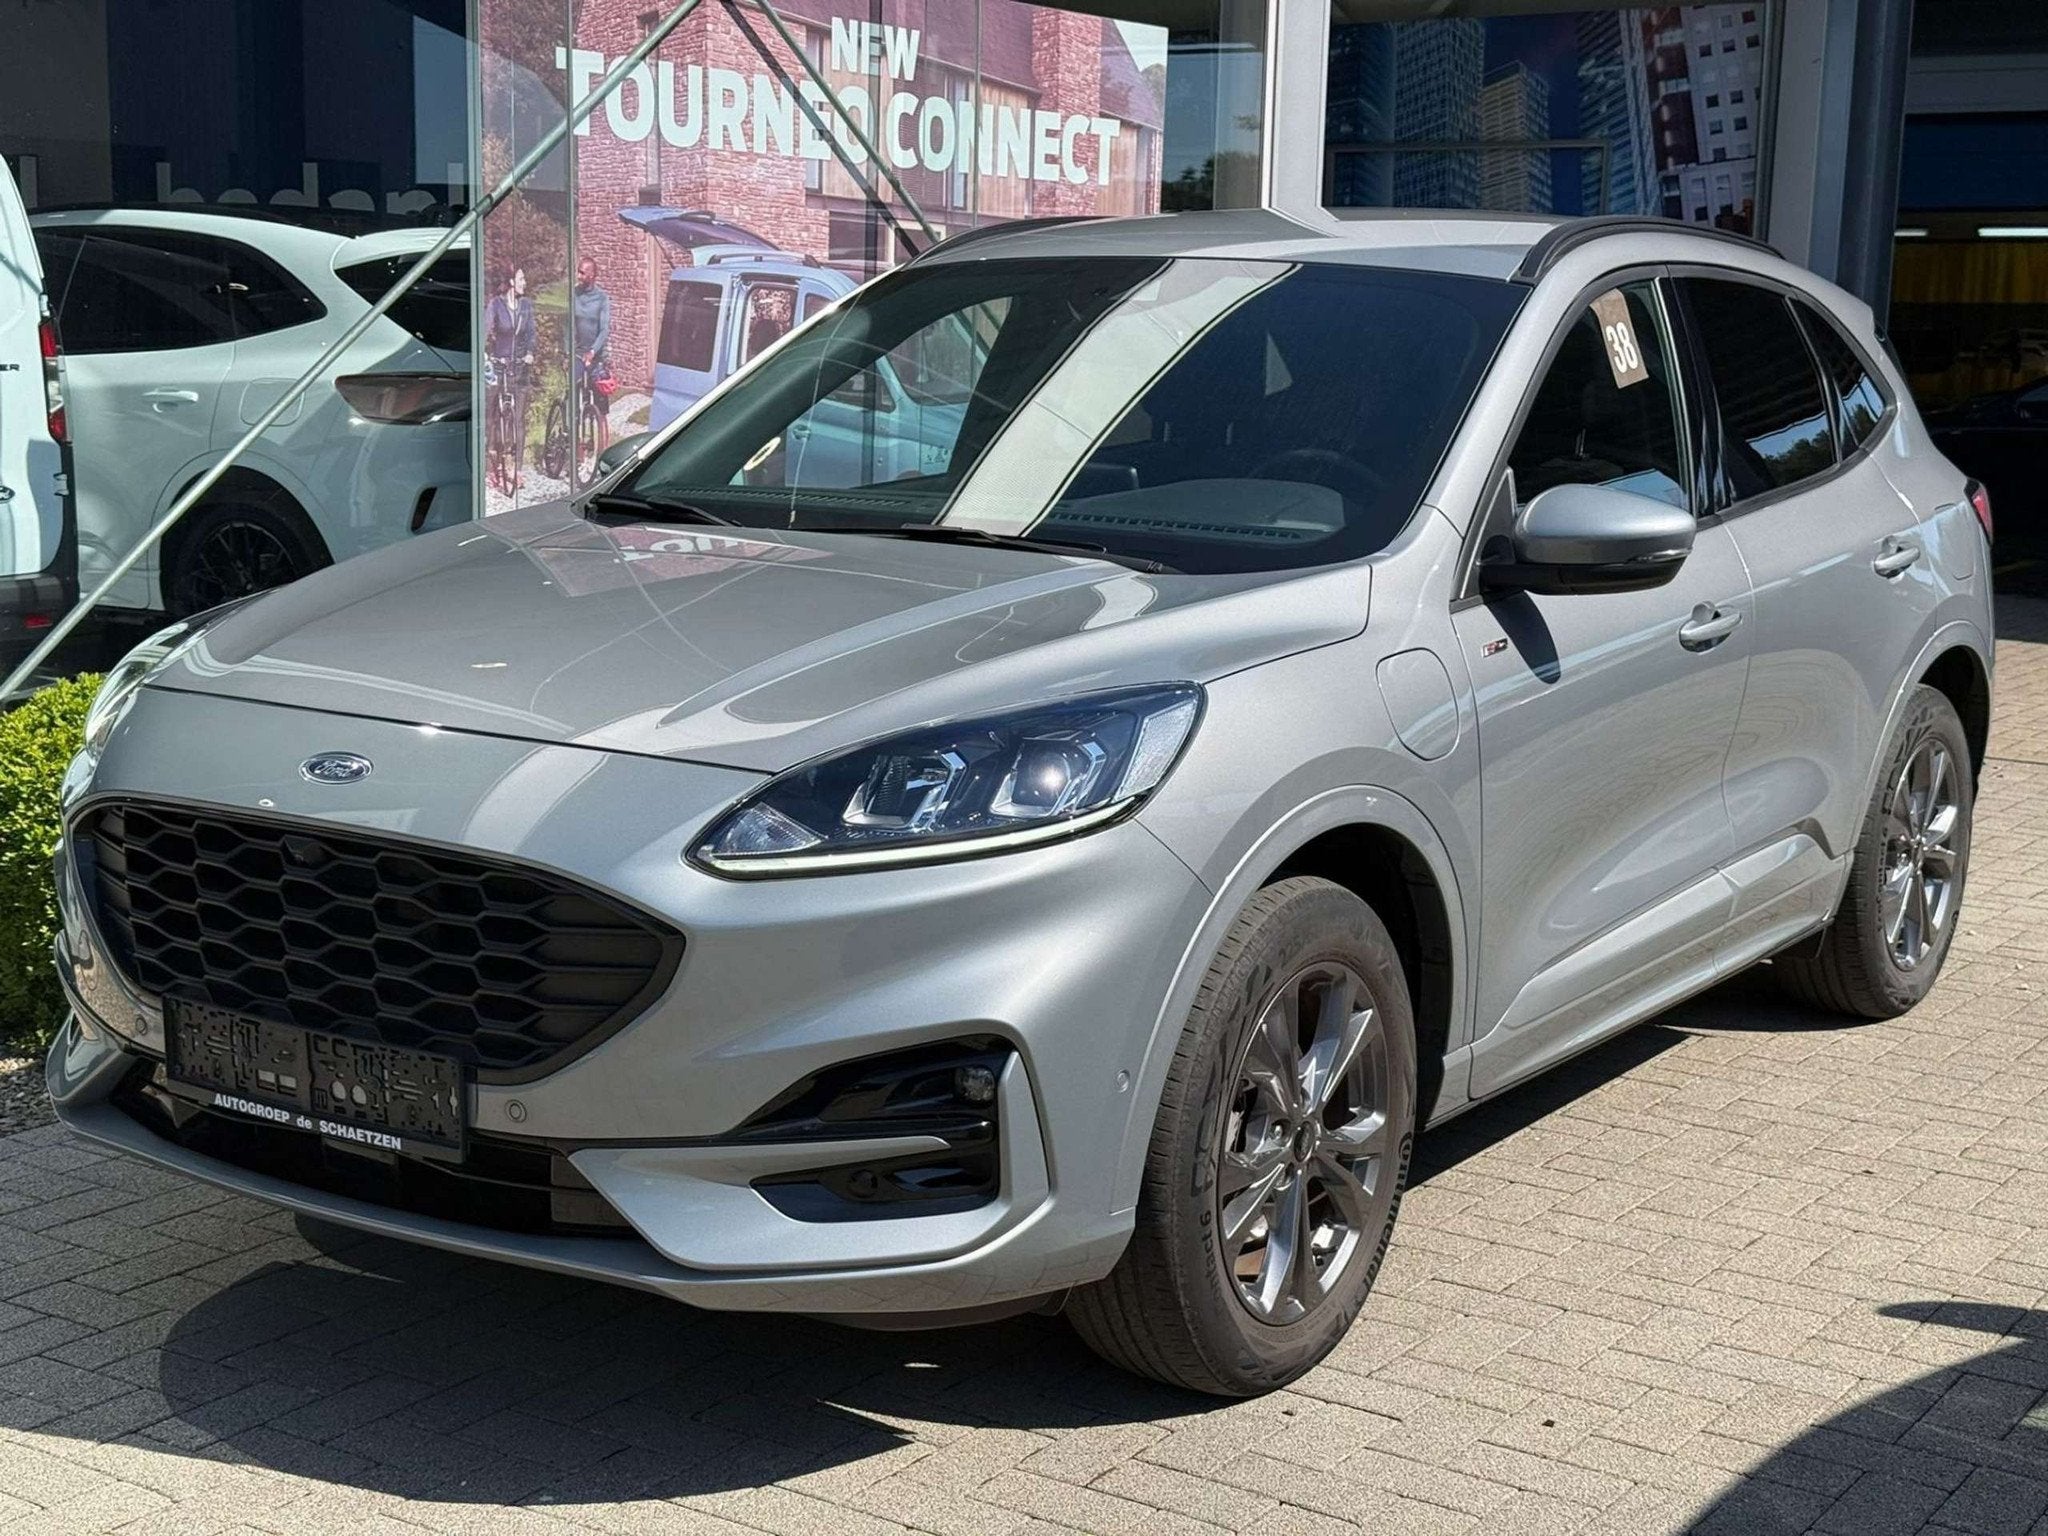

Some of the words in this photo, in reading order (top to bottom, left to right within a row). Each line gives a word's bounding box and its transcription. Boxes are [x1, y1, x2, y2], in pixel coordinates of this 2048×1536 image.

[831, 16, 920, 81] NEW
[555, 46, 875, 166] TOURNEO
[886, 92, 1120, 186] CONNECT
[1606, 322, 1638, 373] 38
[214, 1093, 290, 1123] AUTOGROEP
[297, 1115, 312, 1129] de
[319, 1120, 402, 1150] SCHAETZEN
